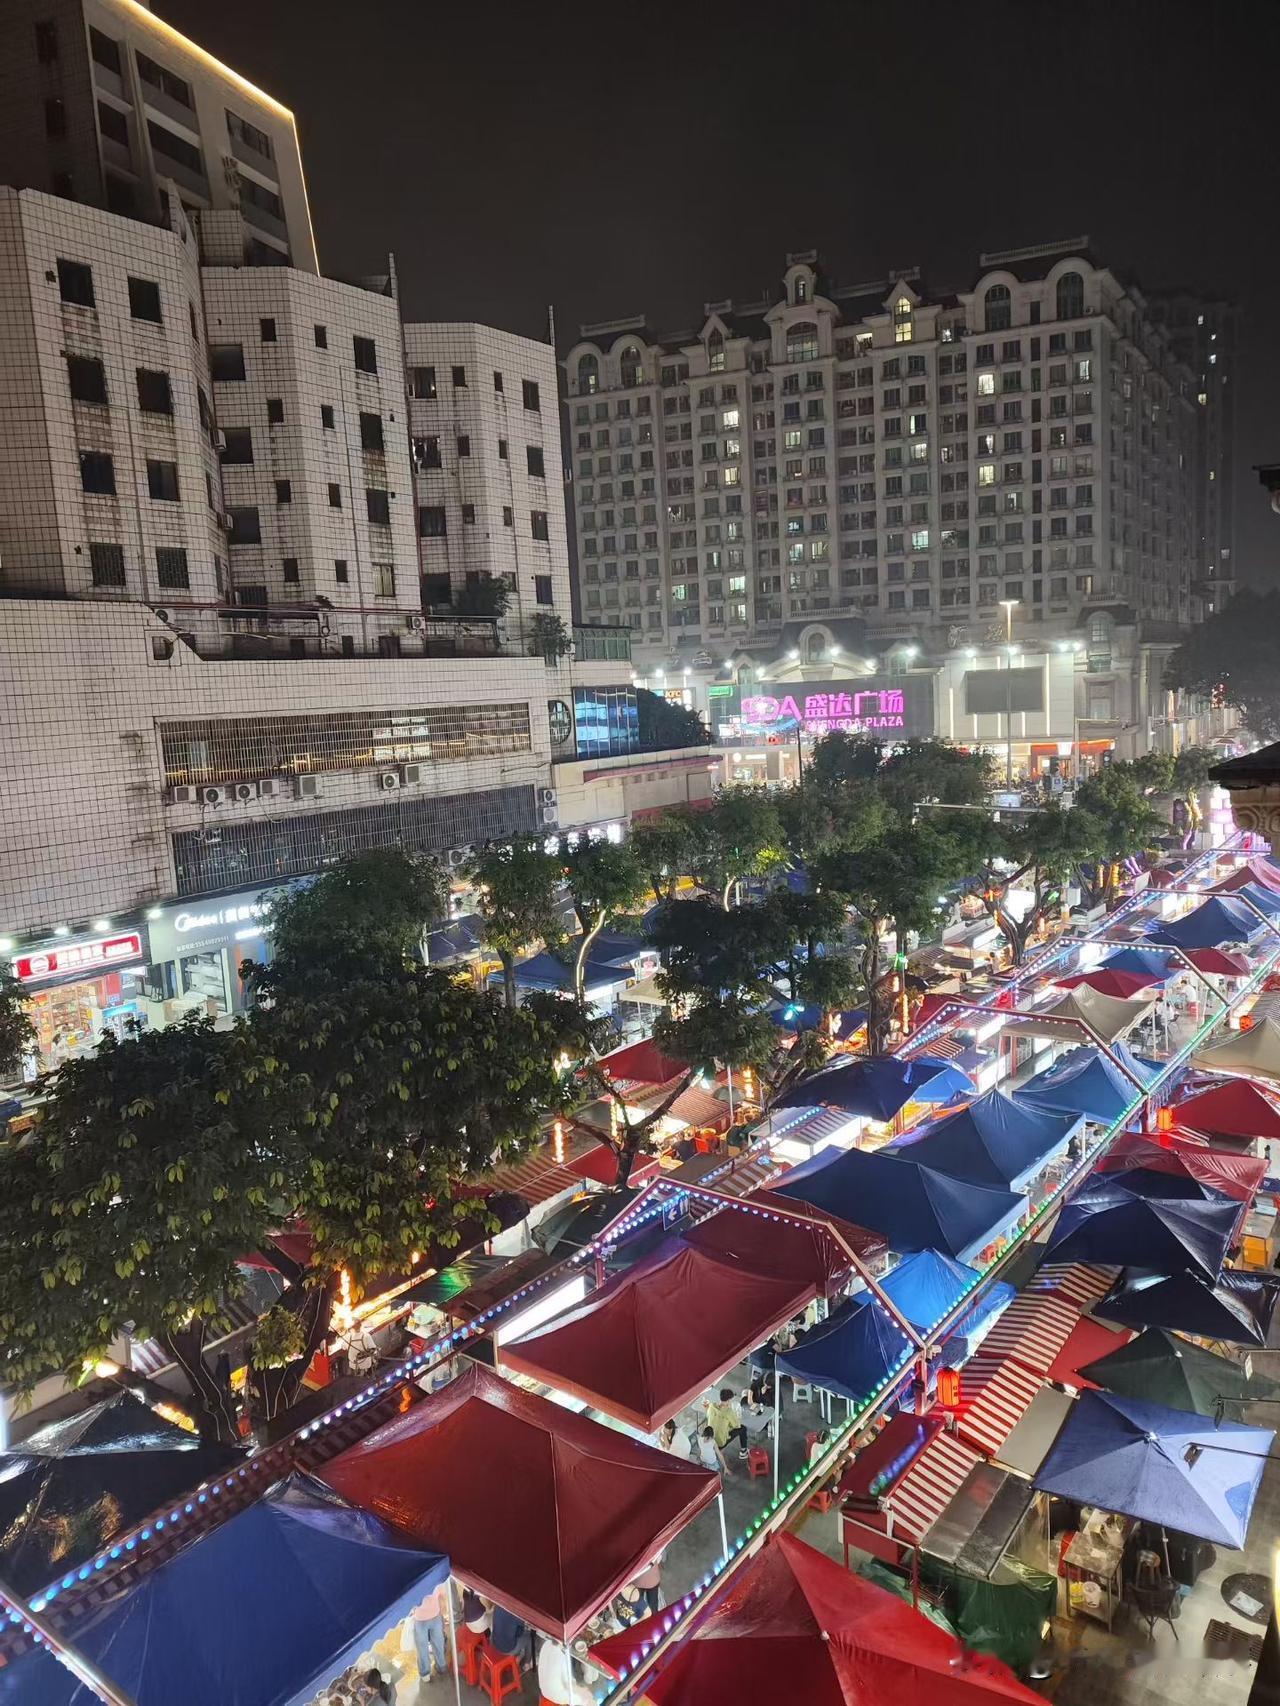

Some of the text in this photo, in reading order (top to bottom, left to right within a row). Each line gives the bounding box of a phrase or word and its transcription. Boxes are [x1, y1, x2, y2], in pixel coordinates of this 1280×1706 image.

[804, 689, 904, 718] 盛达广场
[866, 716, 904, 728] PLAZA
